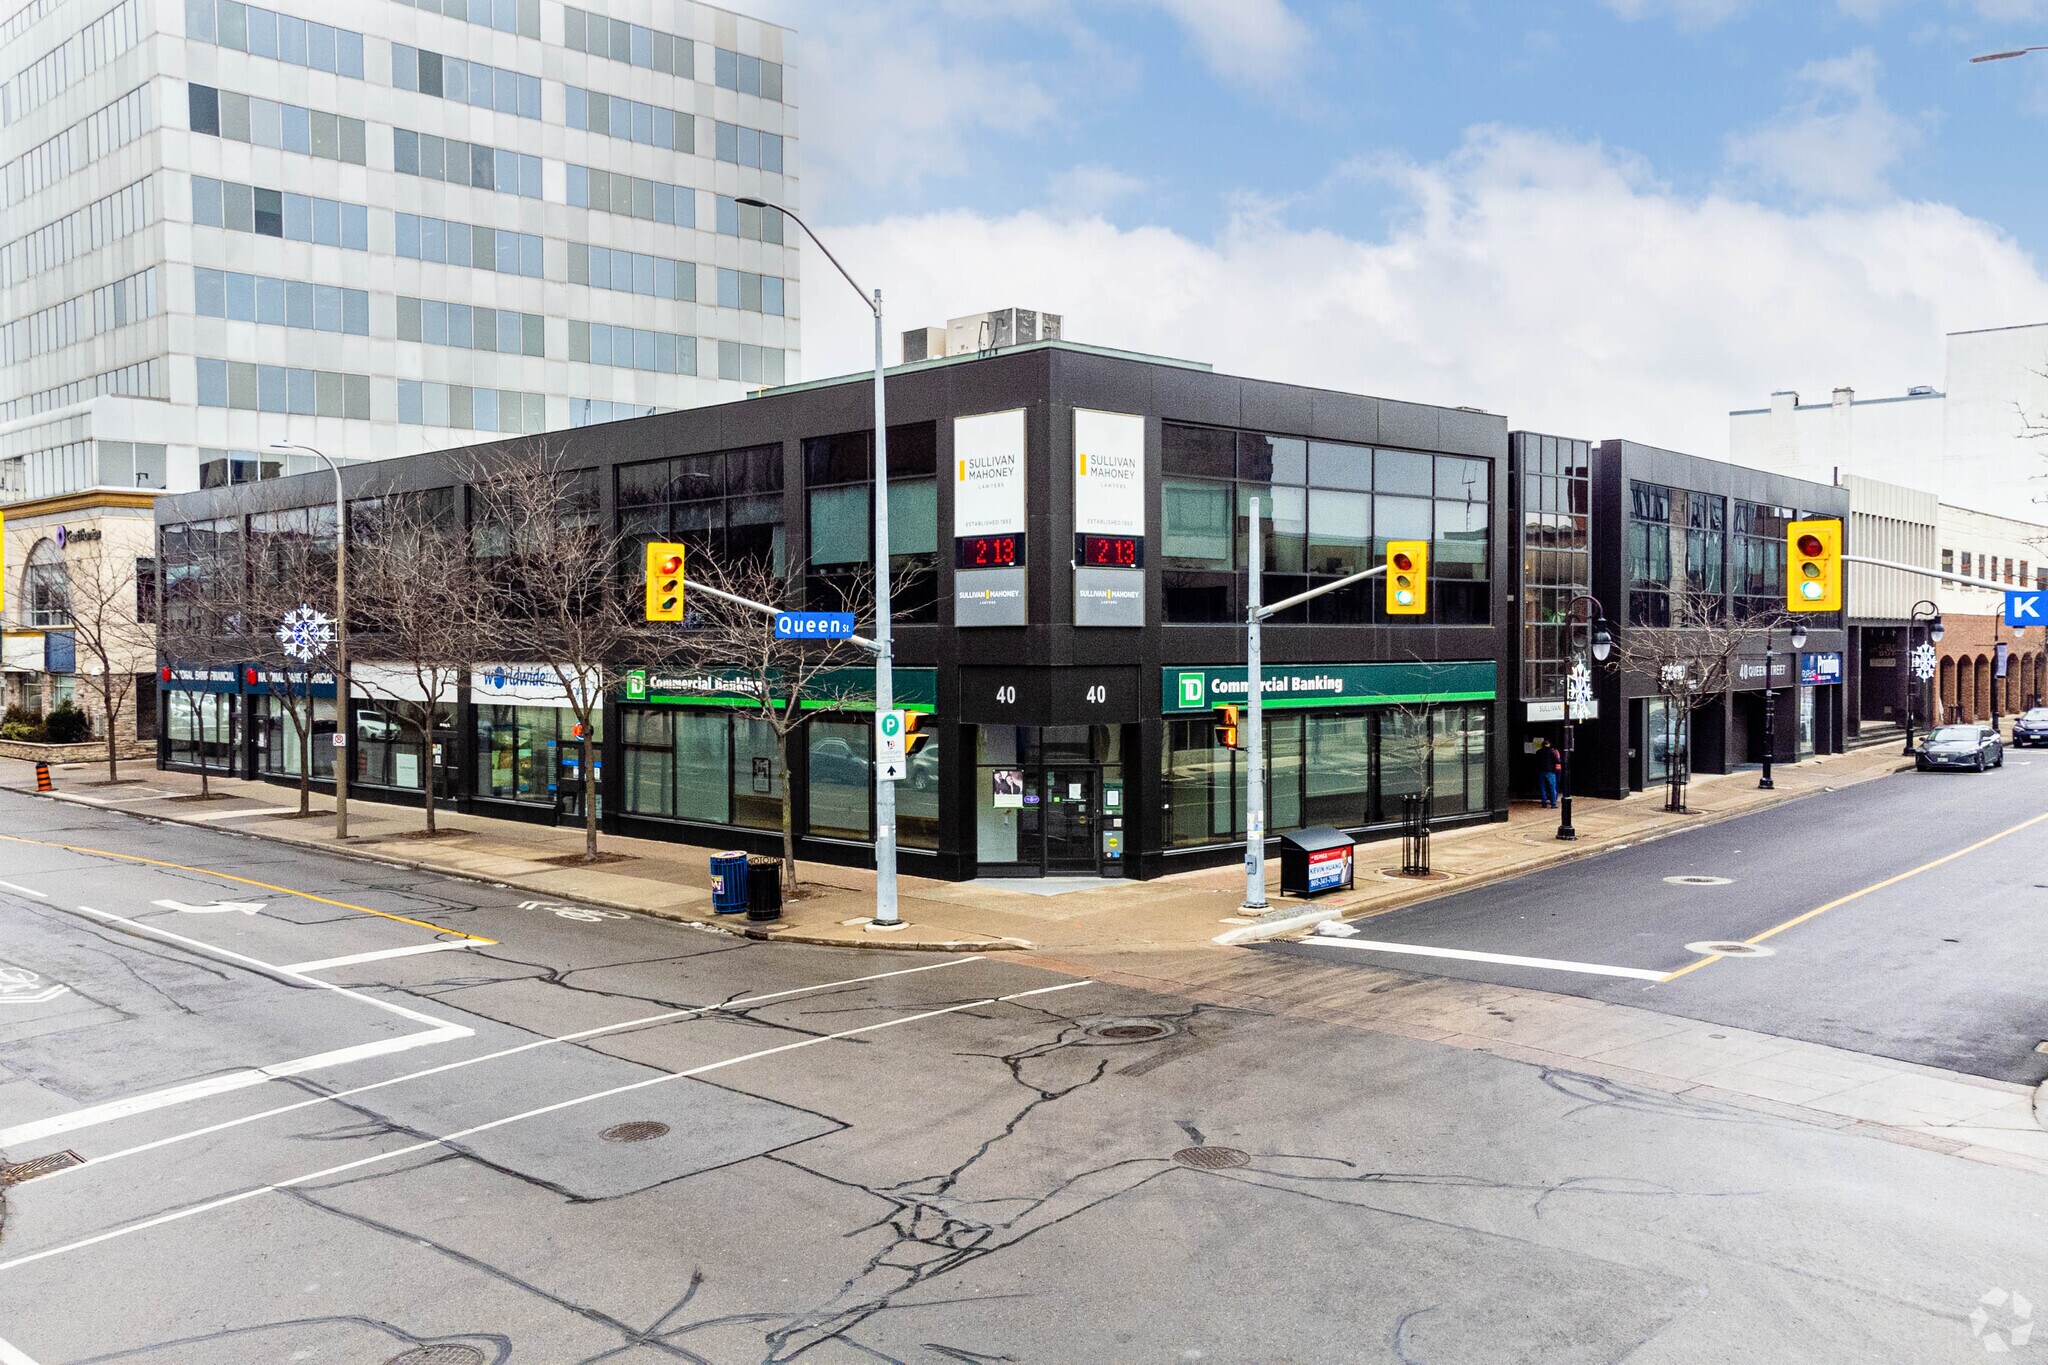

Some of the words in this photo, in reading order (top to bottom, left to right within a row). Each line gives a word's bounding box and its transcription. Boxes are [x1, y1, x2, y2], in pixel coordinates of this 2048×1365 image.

[969, 454, 1015, 469] SULLIVAN
[1090, 454, 1136, 468] SULLIVAN
[969, 467, 1014, 480] MAHONEY
[1090, 467, 1135, 480] MAHONEY
[978, 482, 1005, 490] LAWYERS
[965, 519, 999, 528] ESTABLISHED
[1087, 518, 1121, 526] ESTABLISHED
[959, 591, 986, 599] SULLIVAN
[989, 590, 1020, 598] MAHONEY
[779, 616, 840, 635] Queen
[1740, 664, 1748, 680] 40
[1768, 664, 1786, 676] TREET
[649, 676, 712, 691] Commercial
[714, 676, 763, 695] Banking
[1181, 679, 1203, 701] TD
[1291, 675, 1343, 693] Banking
[996, 686, 1016, 704] 40
[1086, 686, 1106, 704] 40
